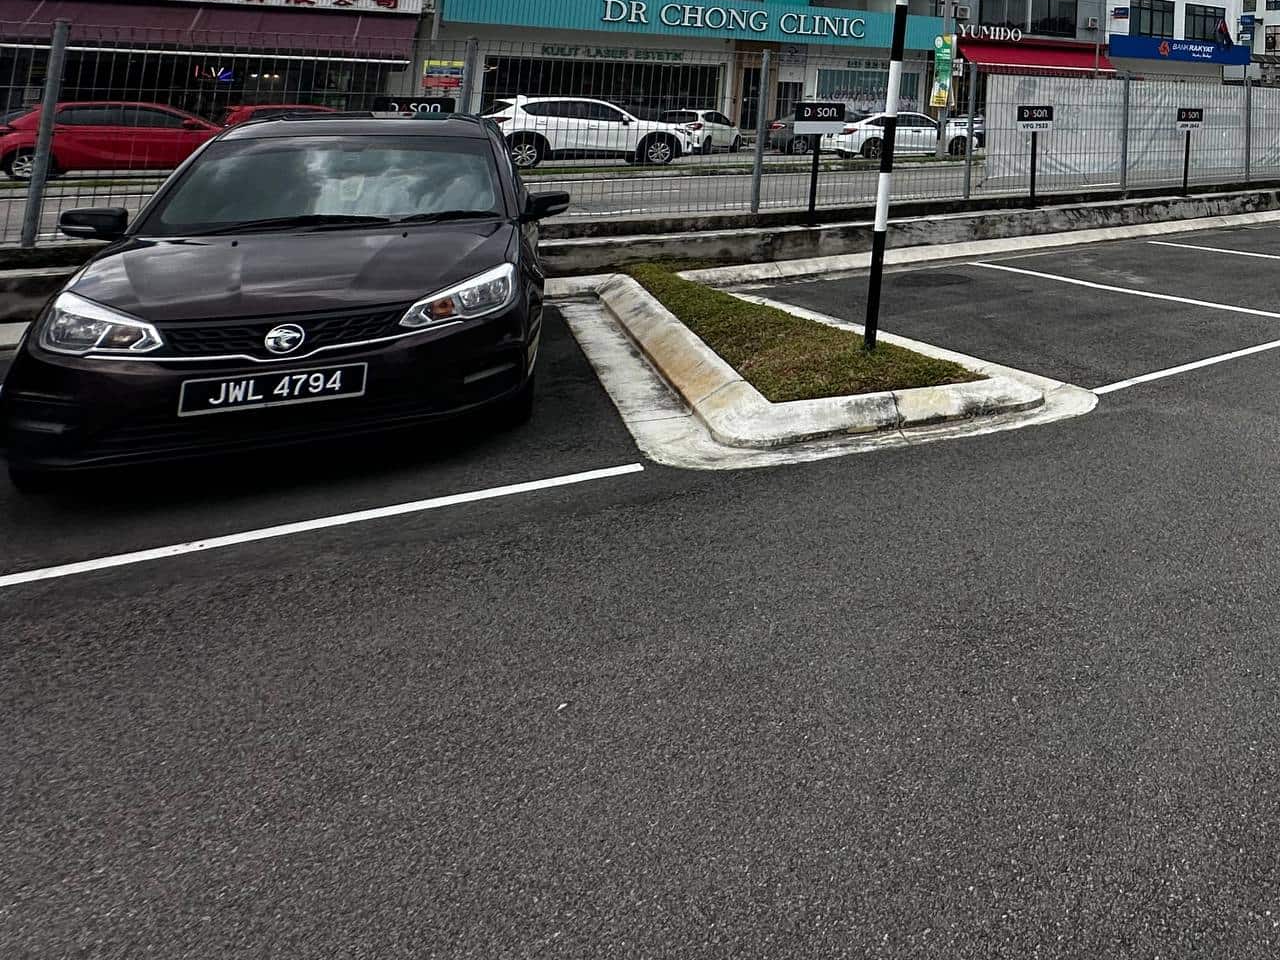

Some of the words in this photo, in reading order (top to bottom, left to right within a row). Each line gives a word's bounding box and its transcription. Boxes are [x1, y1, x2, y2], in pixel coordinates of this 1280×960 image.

[660, 3, 768, 32] CHONG
[780, 13, 865, 38] CLINIC
[959, 23, 1022, 42] YUMIDO
[1189, 44, 1215, 53] RAKYAT
[208, 380, 264, 405] JWL
[273, 370, 342, 397] 4794
